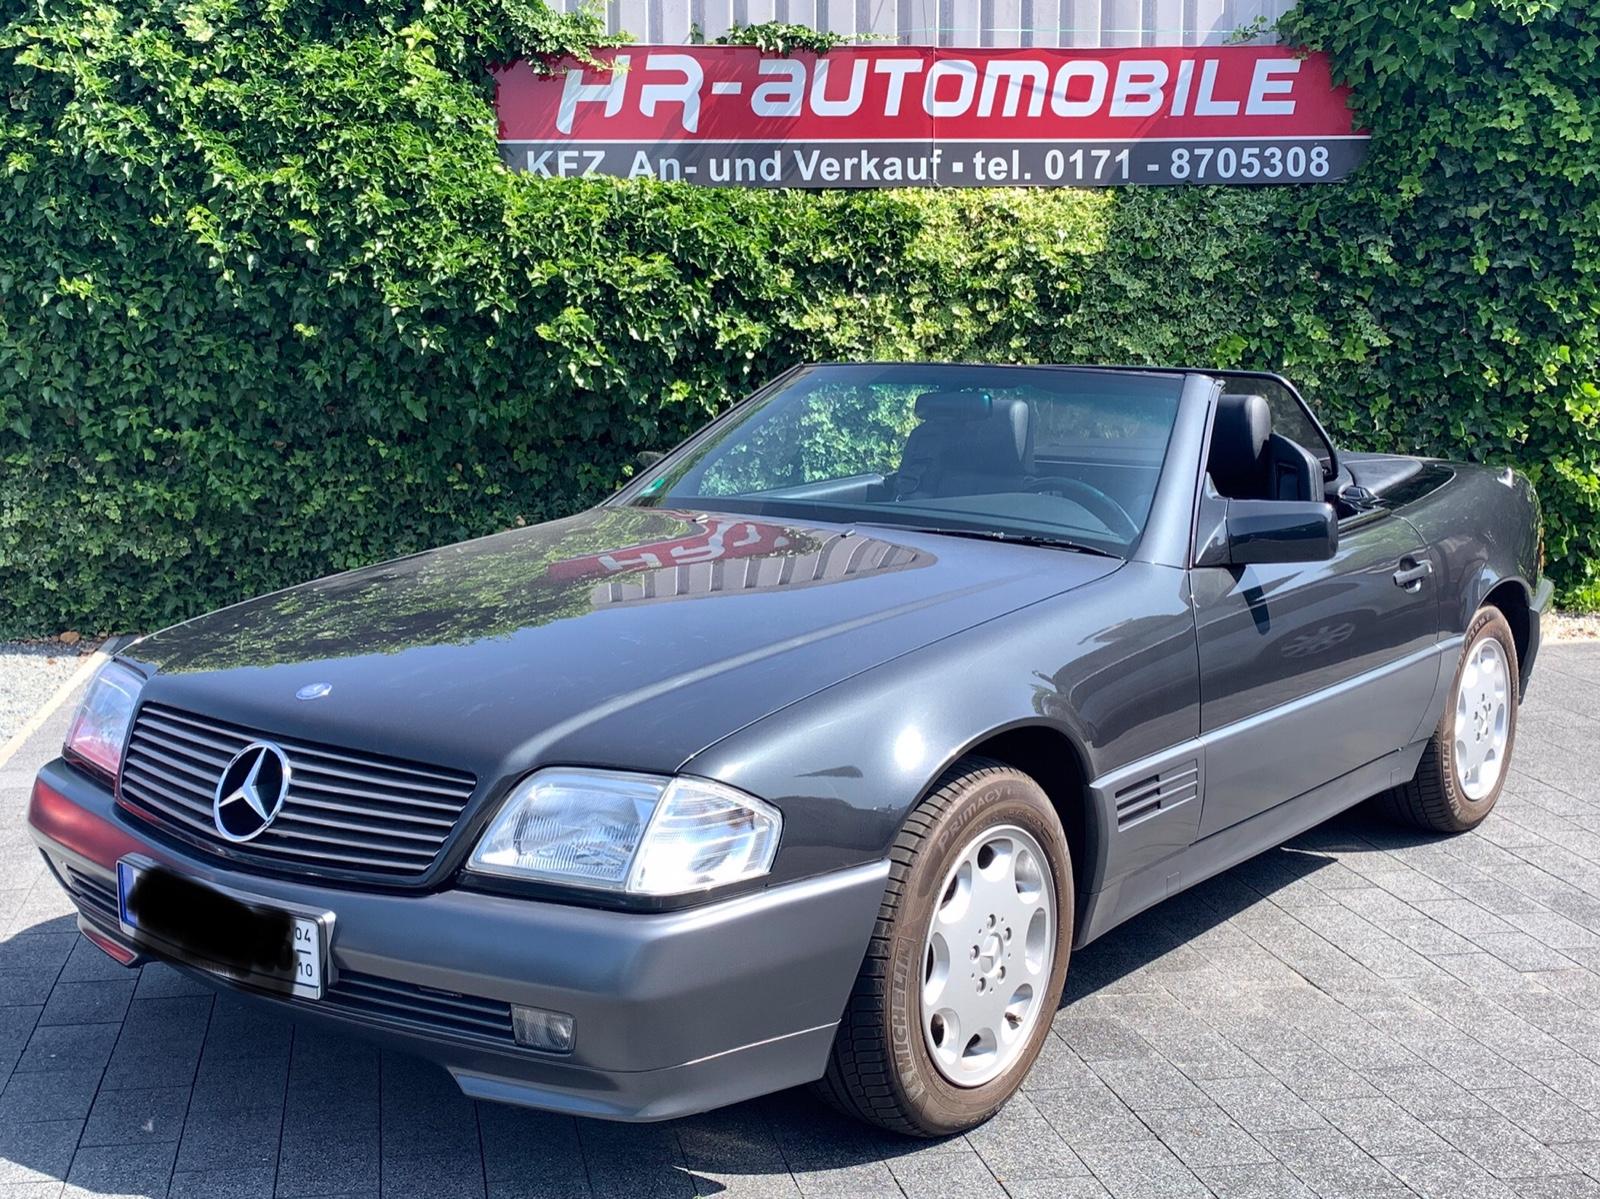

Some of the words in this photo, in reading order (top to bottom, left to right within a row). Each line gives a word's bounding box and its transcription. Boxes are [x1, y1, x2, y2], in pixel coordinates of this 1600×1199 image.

[555, 54, 1301, 134] HR-AUTOMOBILE
[527, 149, 605, 178] KFZ
[629, 149, 697, 180] An-
[709, 149, 782, 182] und
[793, 149, 943, 182] Verkauf
[972, 149, 1031, 181] tel.
[1044, 148, 1130, 180] 0171
[1170, 145, 1330, 180] 8705308
[295, 927, 311, 943] 04
[297, 962, 313, 977] 10
[892, 937, 915, 1075] MICHELIN
